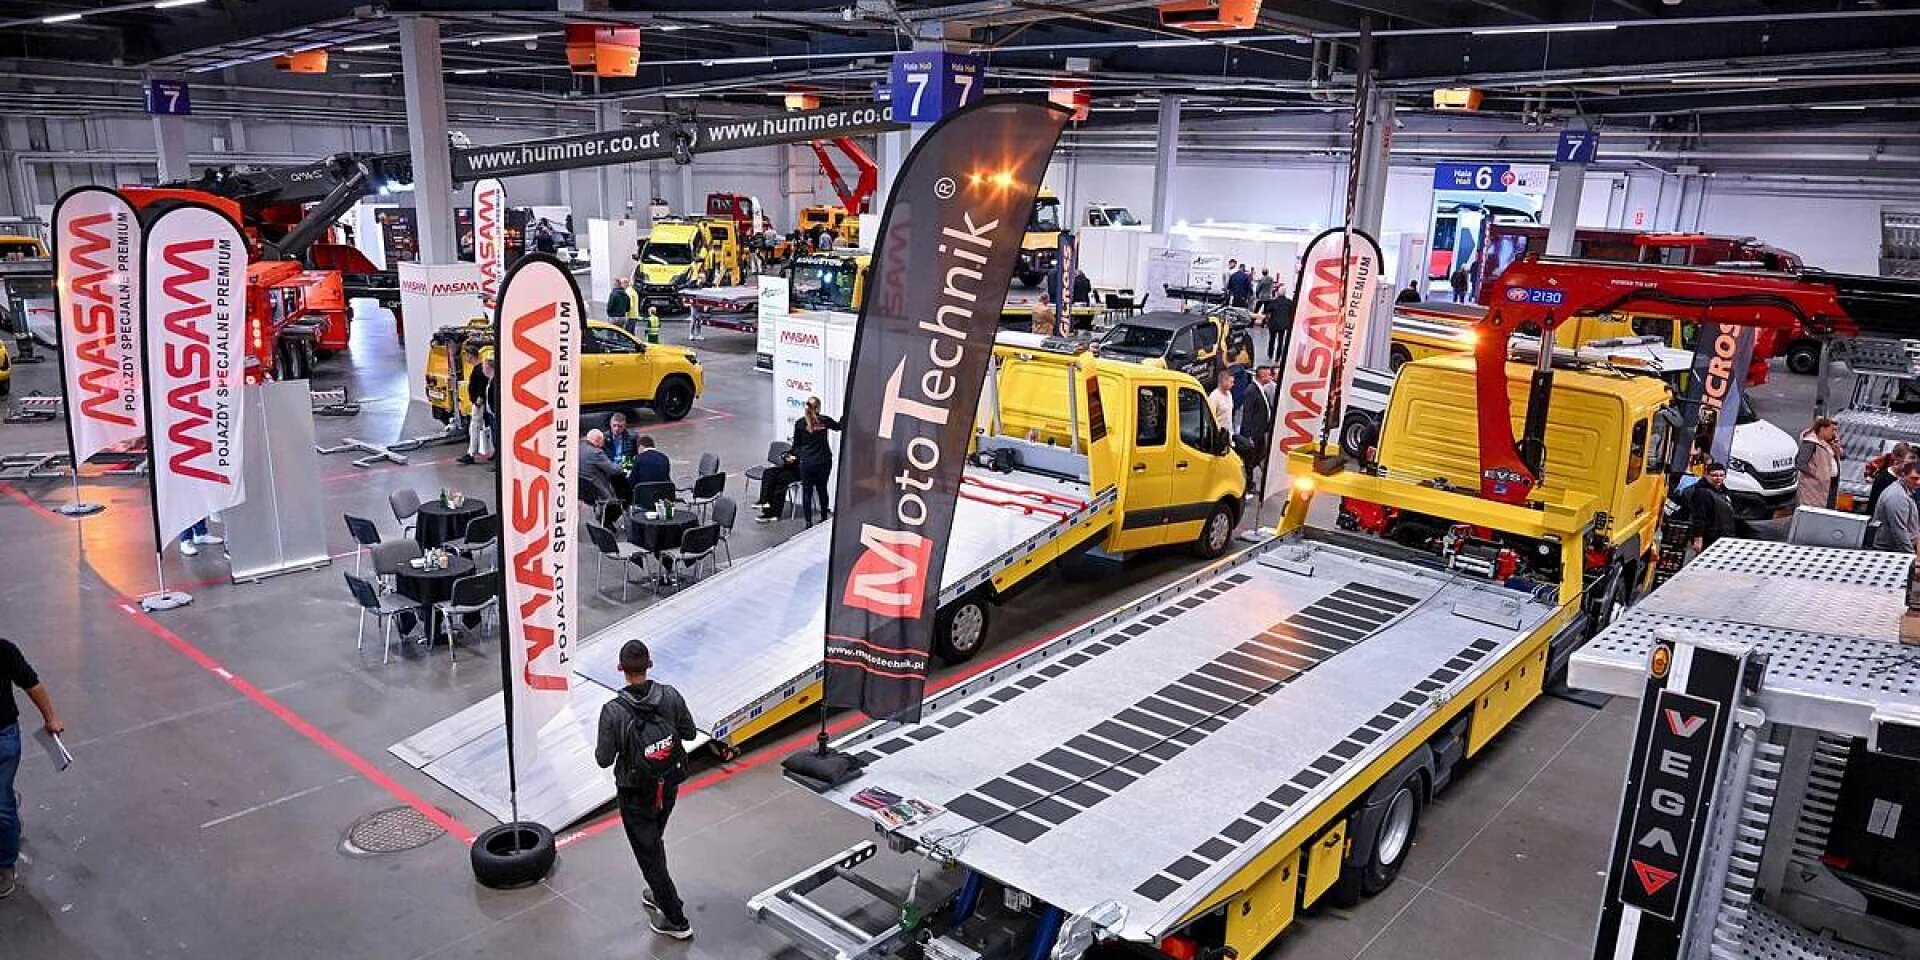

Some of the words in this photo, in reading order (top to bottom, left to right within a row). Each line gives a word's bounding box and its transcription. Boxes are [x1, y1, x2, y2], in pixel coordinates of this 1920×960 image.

[163, 90, 180, 113] 7
[906, 73, 929, 116] 7
[954, 74, 973, 107] 7
[468, 131, 661, 170] www.hummer.co.at
[709, 106, 893, 142] www.hummer.co.a
[1566, 140, 1583, 160] 7
[1475, 166, 1493, 190] 6
[117, 213, 128, 271] PREMIUM
[217, 239, 231, 307] PREMIUM
[431, 282, 479, 296] MASAM
[1349, 256, 1371, 317] PREMIUM
[1532, 290, 1562, 303] 2130
[69, 213, 137, 427] MASAM
[780, 331, 820, 346] MASAM
[121, 354, 135, 411] POJZDY
[163, 239, 231, 485] MASAM
[217, 312, 230, 398] SPECJALNE
[556, 302, 571, 408] PREMIUM
[1280, 255, 1358, 454] MASAM
[216, 402, 230, 466] POJAZDY
[512, 301, 569, 691] MASAM
[553, 418, 568, 553] SPECJALNE
[553, 563, 569, 664] POJAZDY
[1637, 708, 1707, 857] VEGA
